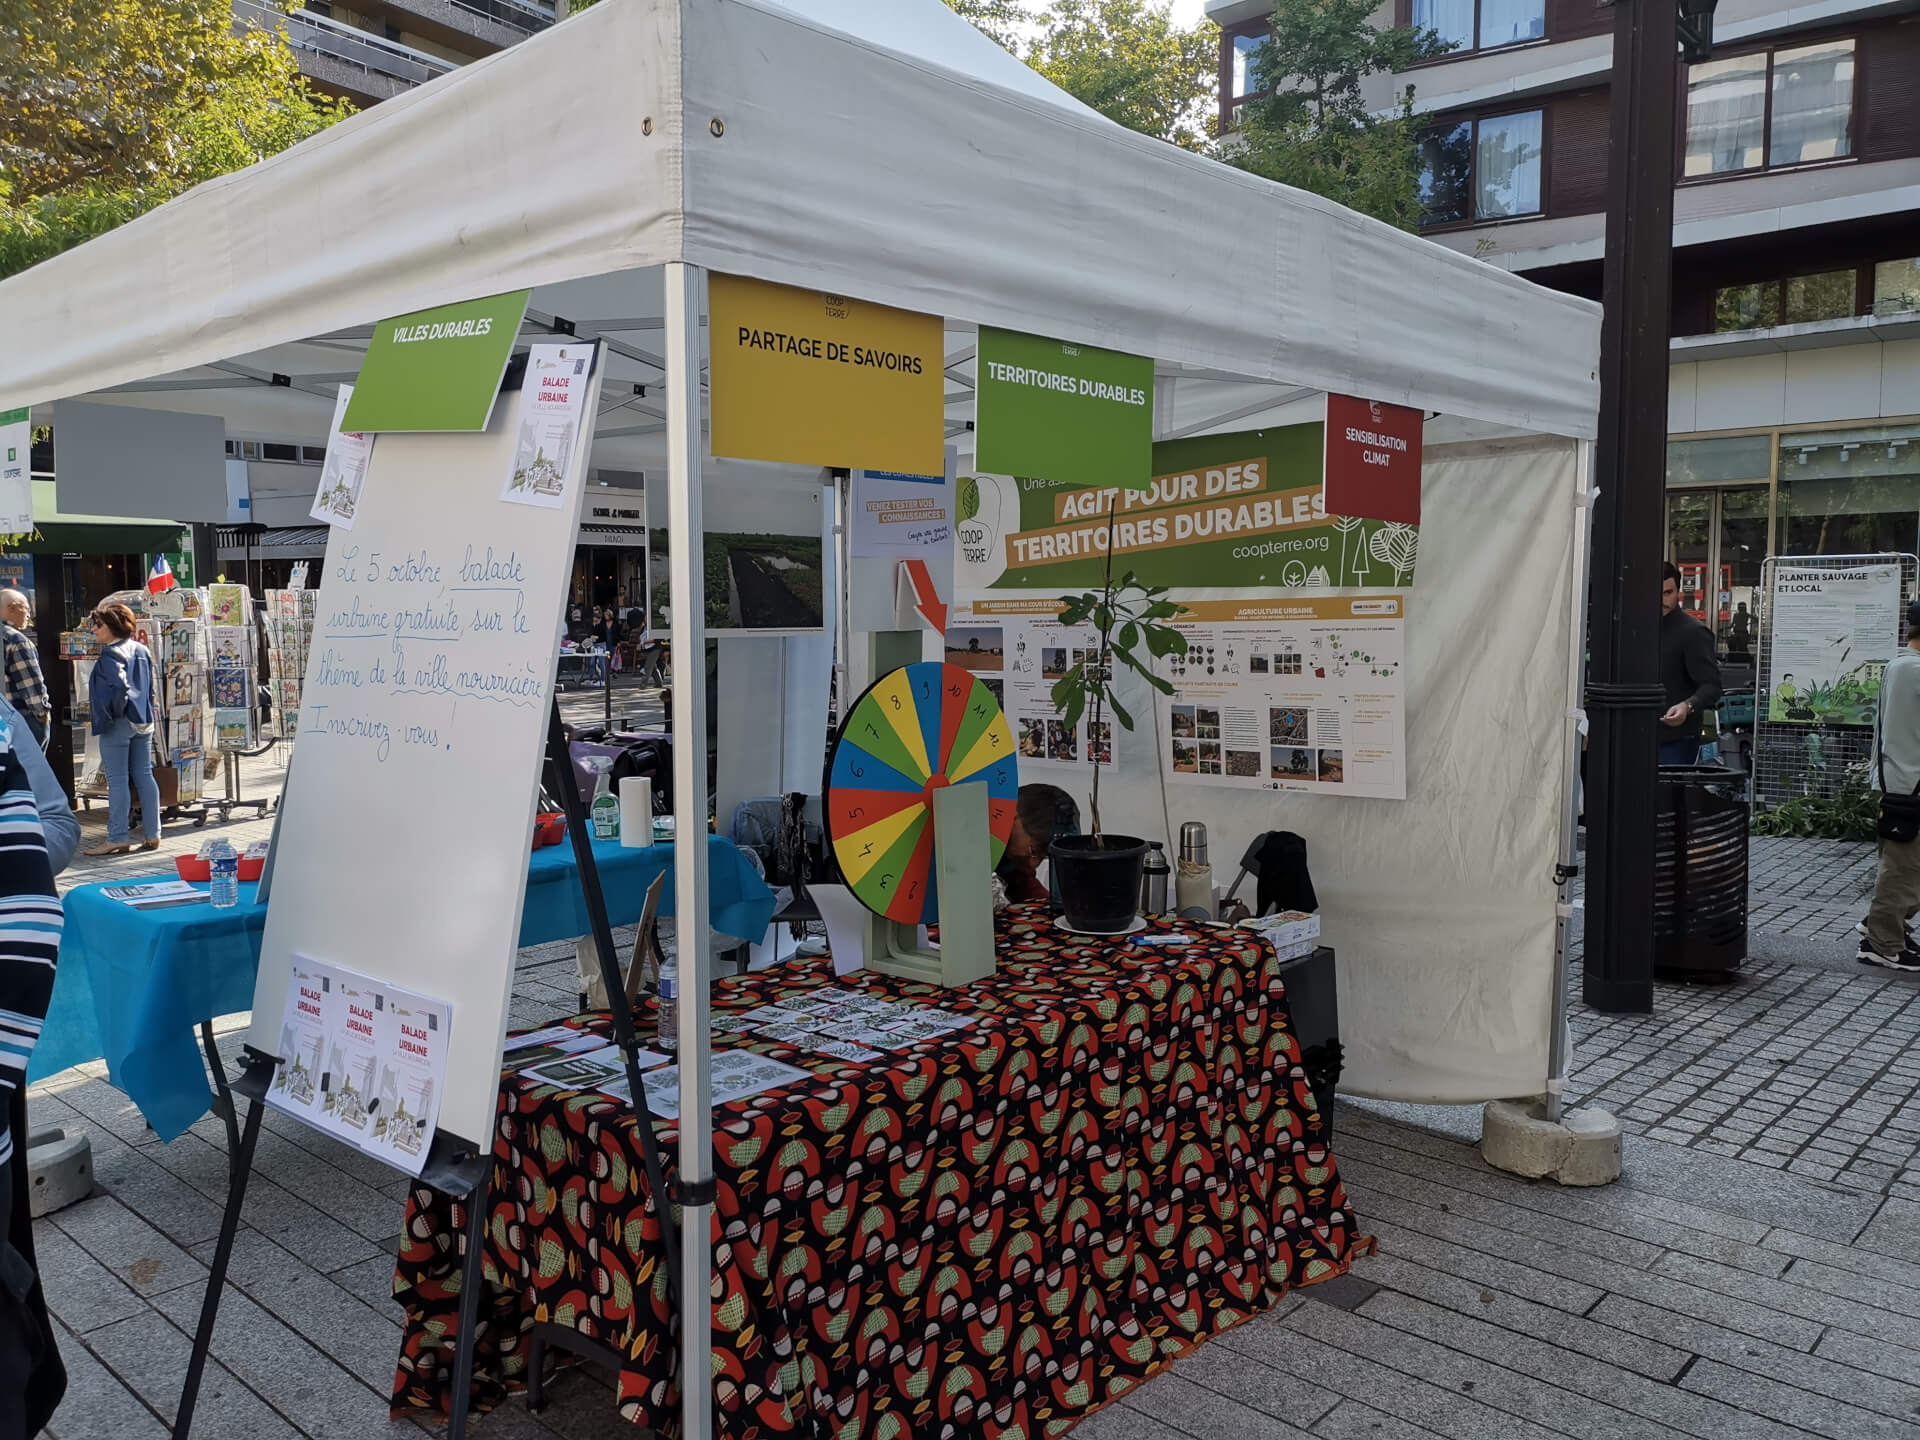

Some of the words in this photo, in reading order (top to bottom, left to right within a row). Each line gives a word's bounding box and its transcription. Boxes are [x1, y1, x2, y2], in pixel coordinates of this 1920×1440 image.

[826, 295, 845, 307] COOP
[825, 307, 847, 319] TERRE
[393, 324, 430, 343] VILLES
[429, 318, 493, 340] DURABLES
[738, 326, 822, 358] PARTAGE
[827, 342, 850, 363] DE
[853, 347, 923, 375] SAVOIRS
[542, 377, 570, 388] BALADE
[988, 361, 1077, 393] TERRITOIRES
[1079, 379, 1146, 406] DURABLES
[537, 392, 568, 403] URBAINE
[1345, 427, 1407, 452] SENSIBILISATION
[1363, 450, 1390, 467] CLIMAT
[1023, 477, 1045, 491] Une
[1061, 487, 1119, 520] AGIT
[1124, 474, 1199, 509] POUR
[1205, 463, 1260, 496] DES
[867, 501, 890, 511] VENEZ
[919, 499, 934, 508] VOS
[881, 510, 940, 522] CONNAISSANCES
[1012, 517, 1169, 562] TERRITOIRES
[1175, 492, 1329, 540] DURABLES
[961, 529, 983, 545] COOP
[963, 548, 986, 563] TERRE
[1232, 536, 1329, 559] coopterre.org
[337, 543, 359, 583] Le
[367, 553, 381, 582] 5
[459, 543, 527, 583] balade
[1822, 572, 1868, 581] SAUVAGE
[326, 595, 390, 629] urbaine
[470, 607, 504, 632] sur
[512, 590, 530, 633] le
[172, 630, 189, 645] 50
[316, 648, 362, 687] thème
[369, 657, 385, 684] de
[393, 651, 406, 686] la
[415, 654, 451, 689] ville
[456, 662, 542, 698] nourricière
[948, 683, 962, 697] 10
[891, 694, 902, 710] 8
[972, 703, 987, 720] 11
[864, 722, 880, 740] 7
[988, 731, 1001, 747] 12
[850, 759, 864, 778] 6
[997, 767, 1008, 784] 13
[849, 807, 865, 818] 5
[858, 841, 874, 858] 4
[879, 873, 895, 889] 3
[300, 986, 321, 1002] BALADE
[297, 1000, 320, 1017] URBAINE
[349, 1004, 373, 1020] BALADE
[346, 1018, 372, 1036] URBAINE
[401, 1023, 427, 1041] BALADE
[399, 1039, 428, 1057] URBAINE
